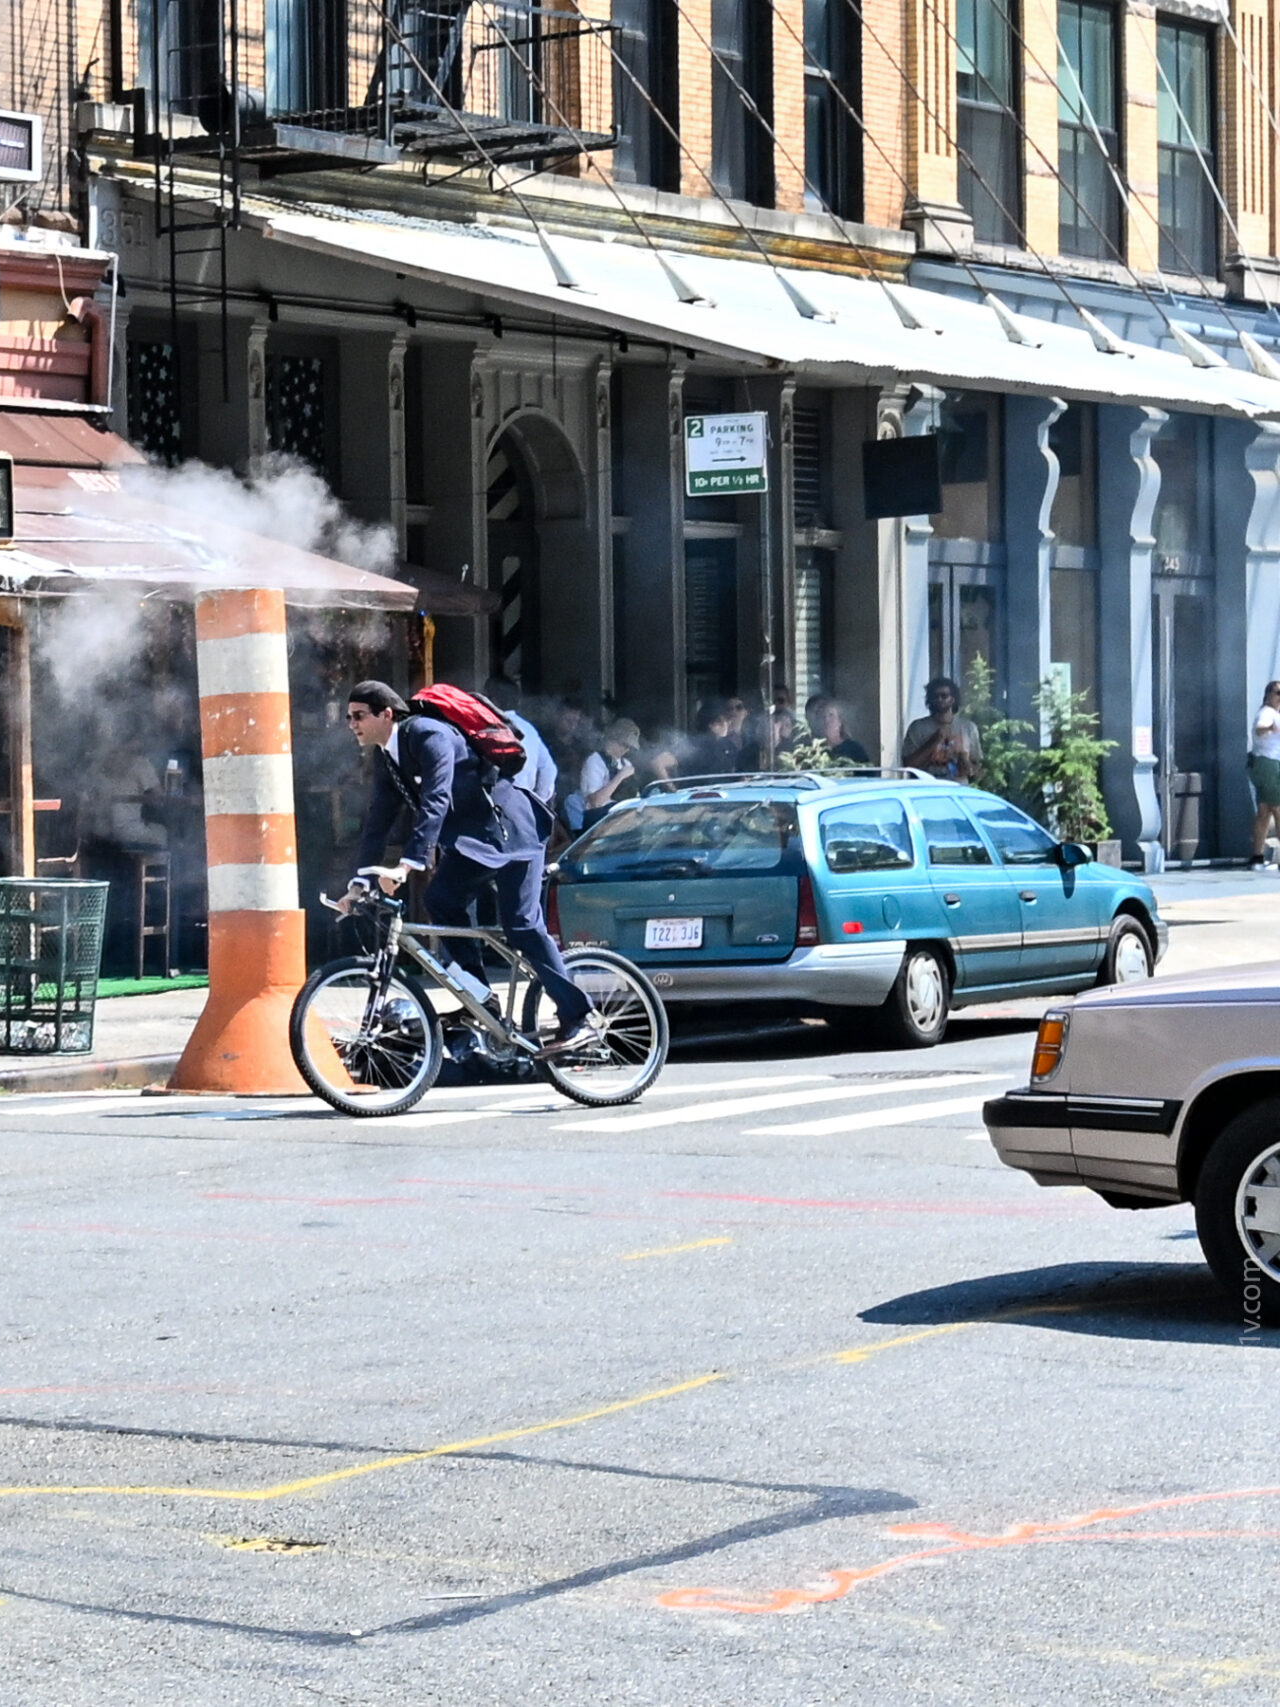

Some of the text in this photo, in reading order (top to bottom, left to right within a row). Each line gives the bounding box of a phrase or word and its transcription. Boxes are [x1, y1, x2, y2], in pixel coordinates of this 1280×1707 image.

[690, 420, 702, 437] 2
[710, 424, 754, 434] PARKING
[710, 476, 730, 487] PER
[746, 474, 760, 484] HR
[652, 927, 671, 942] T22
